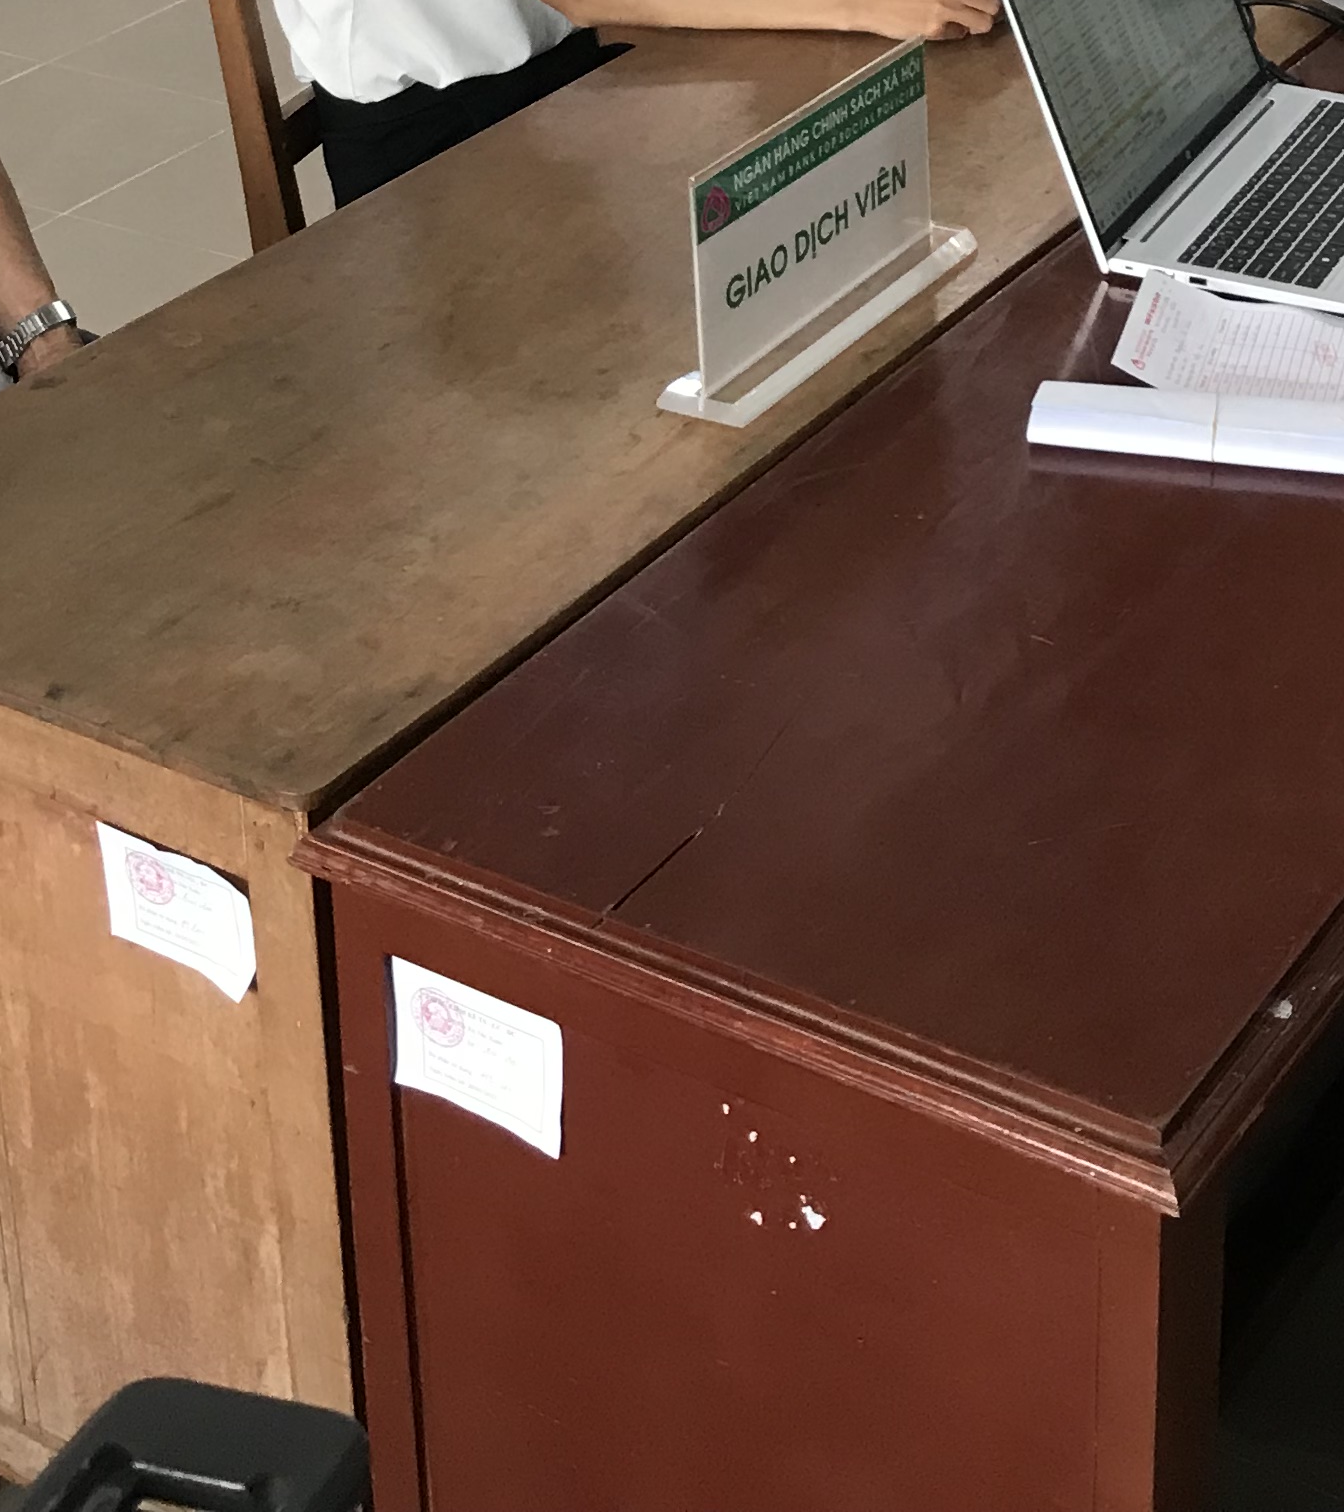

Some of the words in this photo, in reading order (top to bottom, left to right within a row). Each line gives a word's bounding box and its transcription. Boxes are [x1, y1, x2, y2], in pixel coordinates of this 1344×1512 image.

[733, 152, 771, 191] NGÂN
[774, 129, 809, 165] HÀNG
[811, 104, 849, 139] CHÍNH
[850, 84, 881, 115] SÁCH
[883, 70, 899, 95] XÃ
[901, 57, 921, 83] HỘI
[726, 244, 788, 308] GIAO
[794, 199, 849, 263] DỊCH
[855, 160, 907, 218] VIÊN
